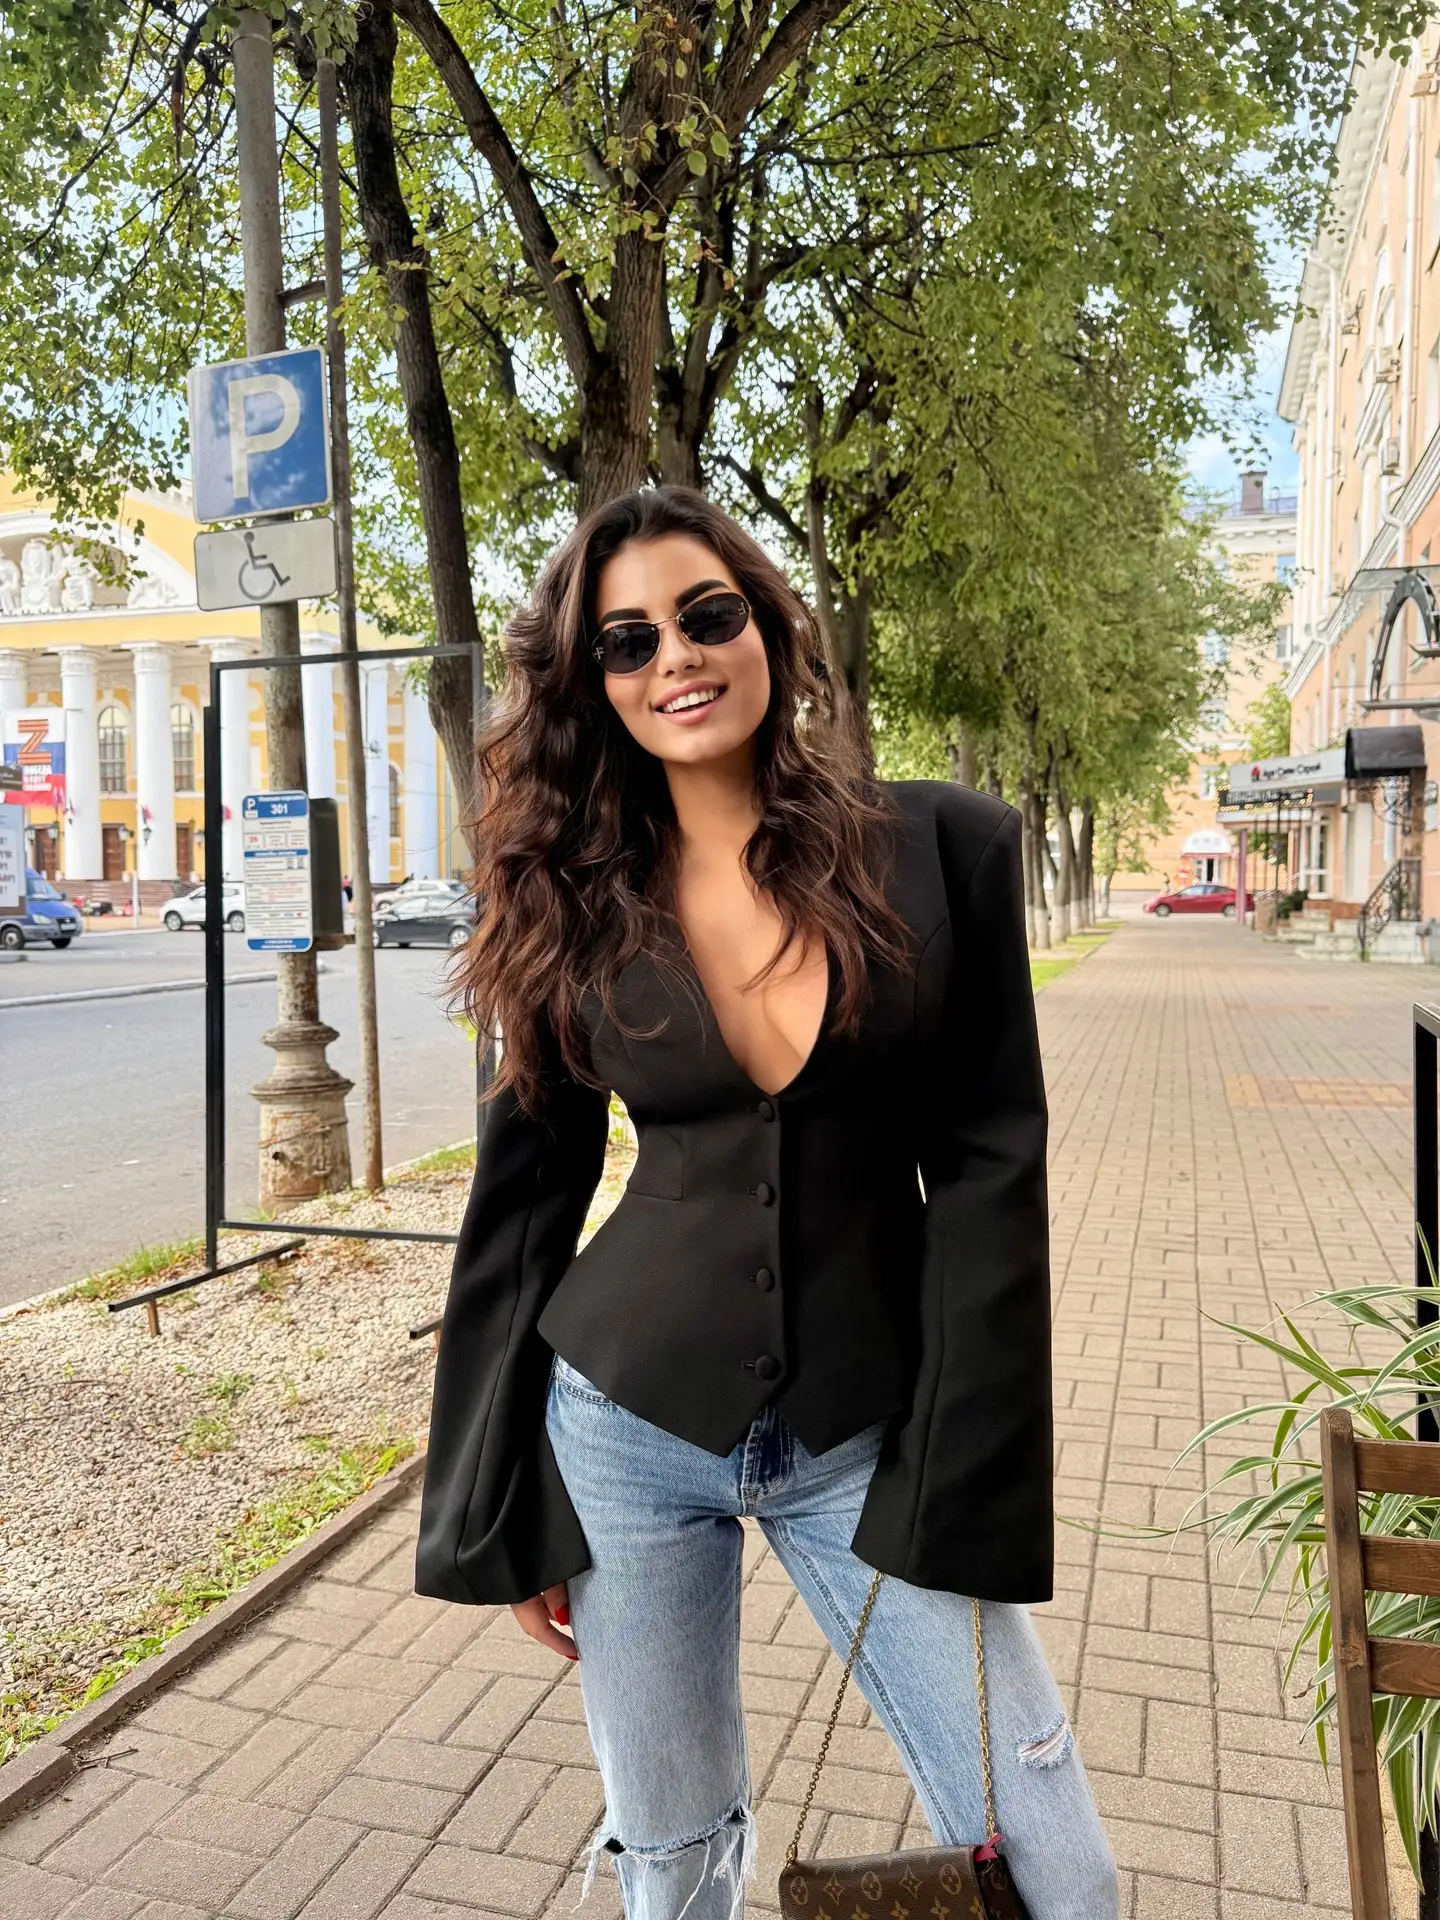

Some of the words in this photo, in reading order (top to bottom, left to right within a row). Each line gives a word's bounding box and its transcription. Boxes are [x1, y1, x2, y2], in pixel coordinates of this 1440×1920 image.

[228, 373, 301, 499] P
[17, 718, 52, 766] Z
[246, 797, 256, 810] P
[270, 803, 289, 815] 301
